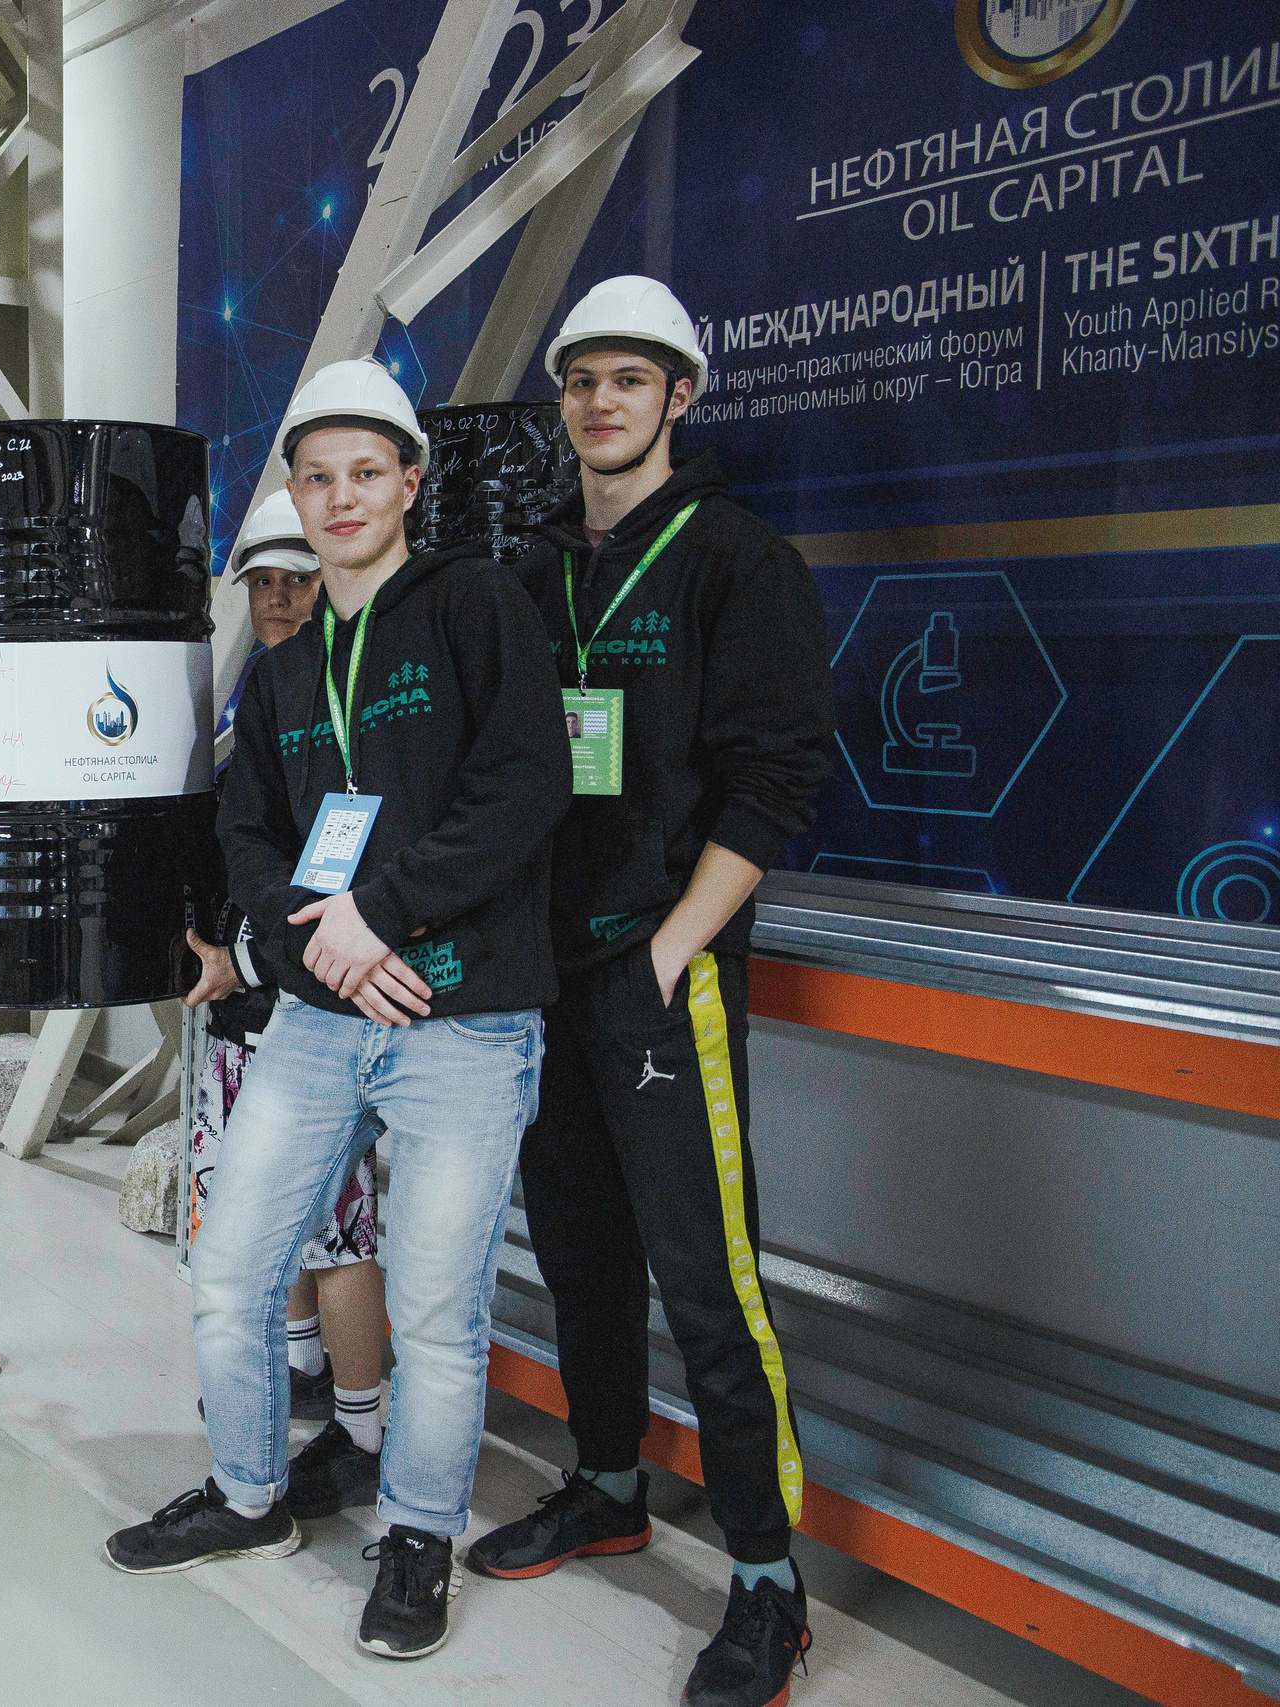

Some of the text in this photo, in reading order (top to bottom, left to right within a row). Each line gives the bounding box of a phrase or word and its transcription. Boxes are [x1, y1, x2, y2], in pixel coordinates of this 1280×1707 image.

[810, 106, 1049, 205] НЕФТЯНАЯ
[903, 138, 1204, 241] OIL CAPITAL
[1064, 215, 1280, 294] THE SIXTH
[724, 255, 1025, 353] МЕЖДУНАРОДНЫЙ
[1064, 301, 1133, 339] Youth
[1141, 281, 1249, 332] Applied
[726, 335, 932, 392] научно-практический
[939, 326, 1023, 358] форум
[749, 379, 867, 419] автономный
[872, 373, 930, 403] округ
[960, 359, 1023, 391] Югра
[387, 704, 433, 722] КОМИ
[64, 755, 158, 767] НЕФТЯНАЯ СТОЛИЦА
[82, 771, 137, 782] OIL CAPITAL
